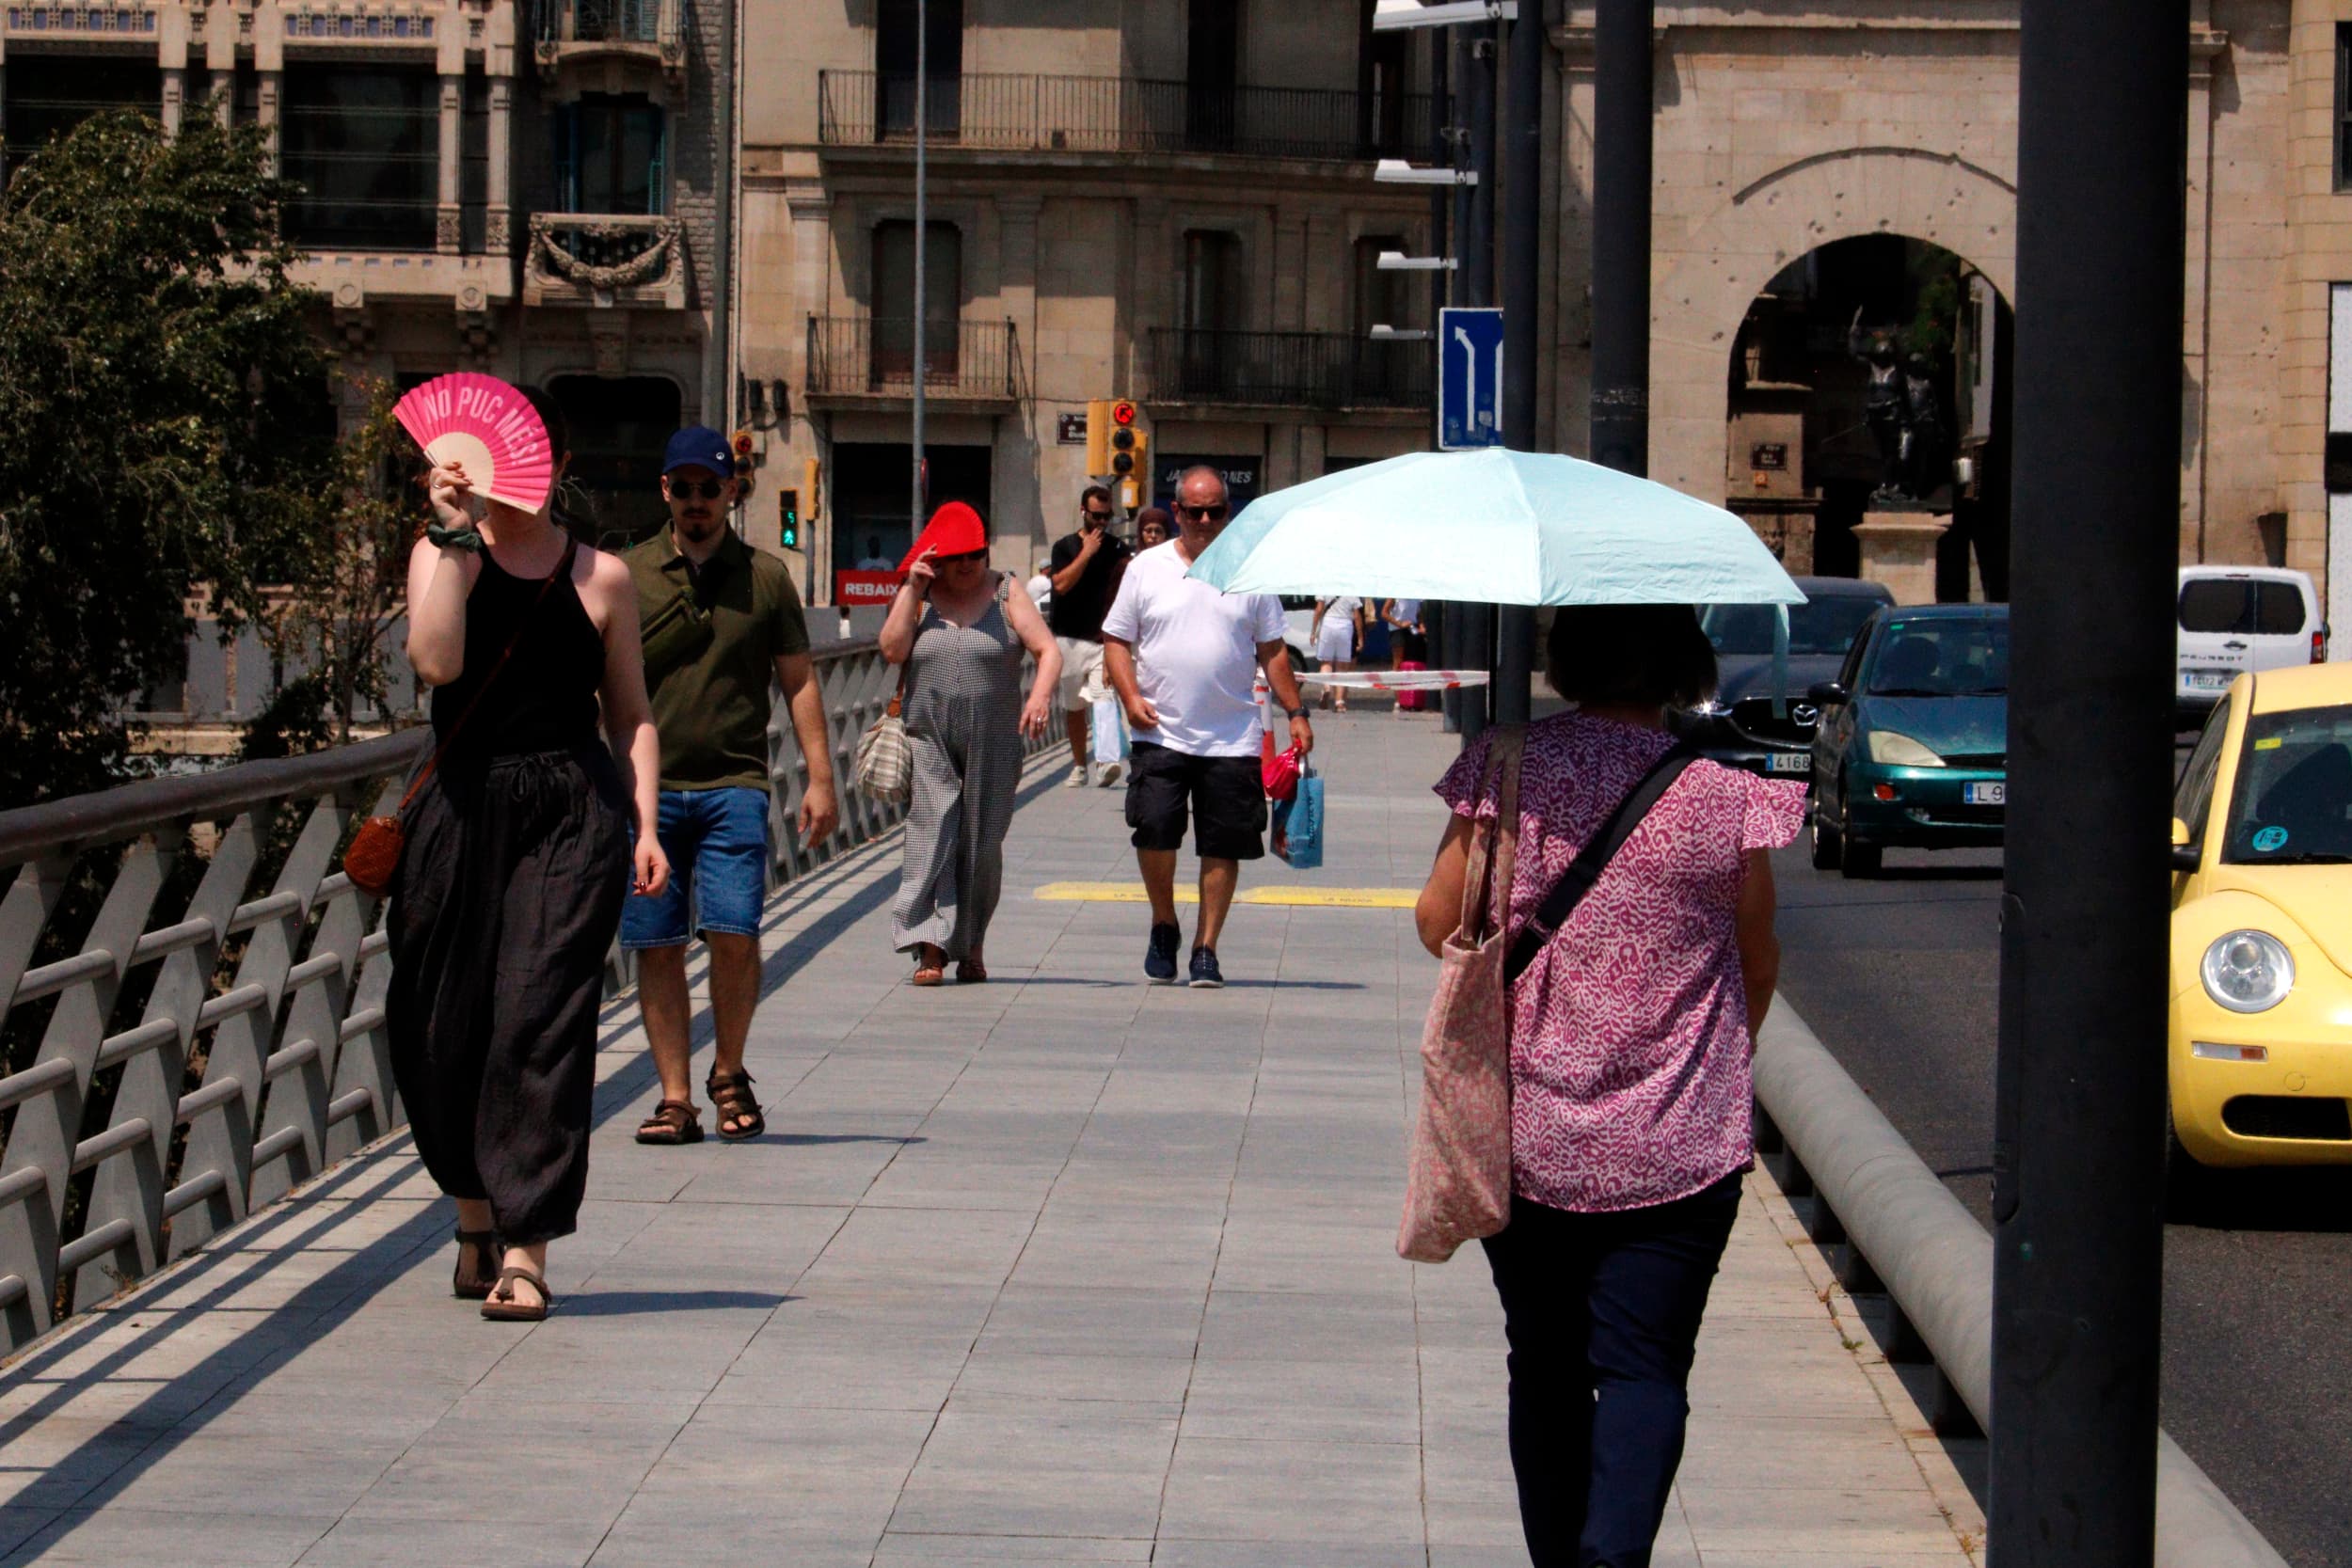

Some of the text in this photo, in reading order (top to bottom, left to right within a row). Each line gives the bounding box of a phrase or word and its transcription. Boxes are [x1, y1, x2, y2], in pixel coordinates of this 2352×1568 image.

[424, 387, 540, 467] NO PUC MÉS!
[787, 512, 795, 524] 5
